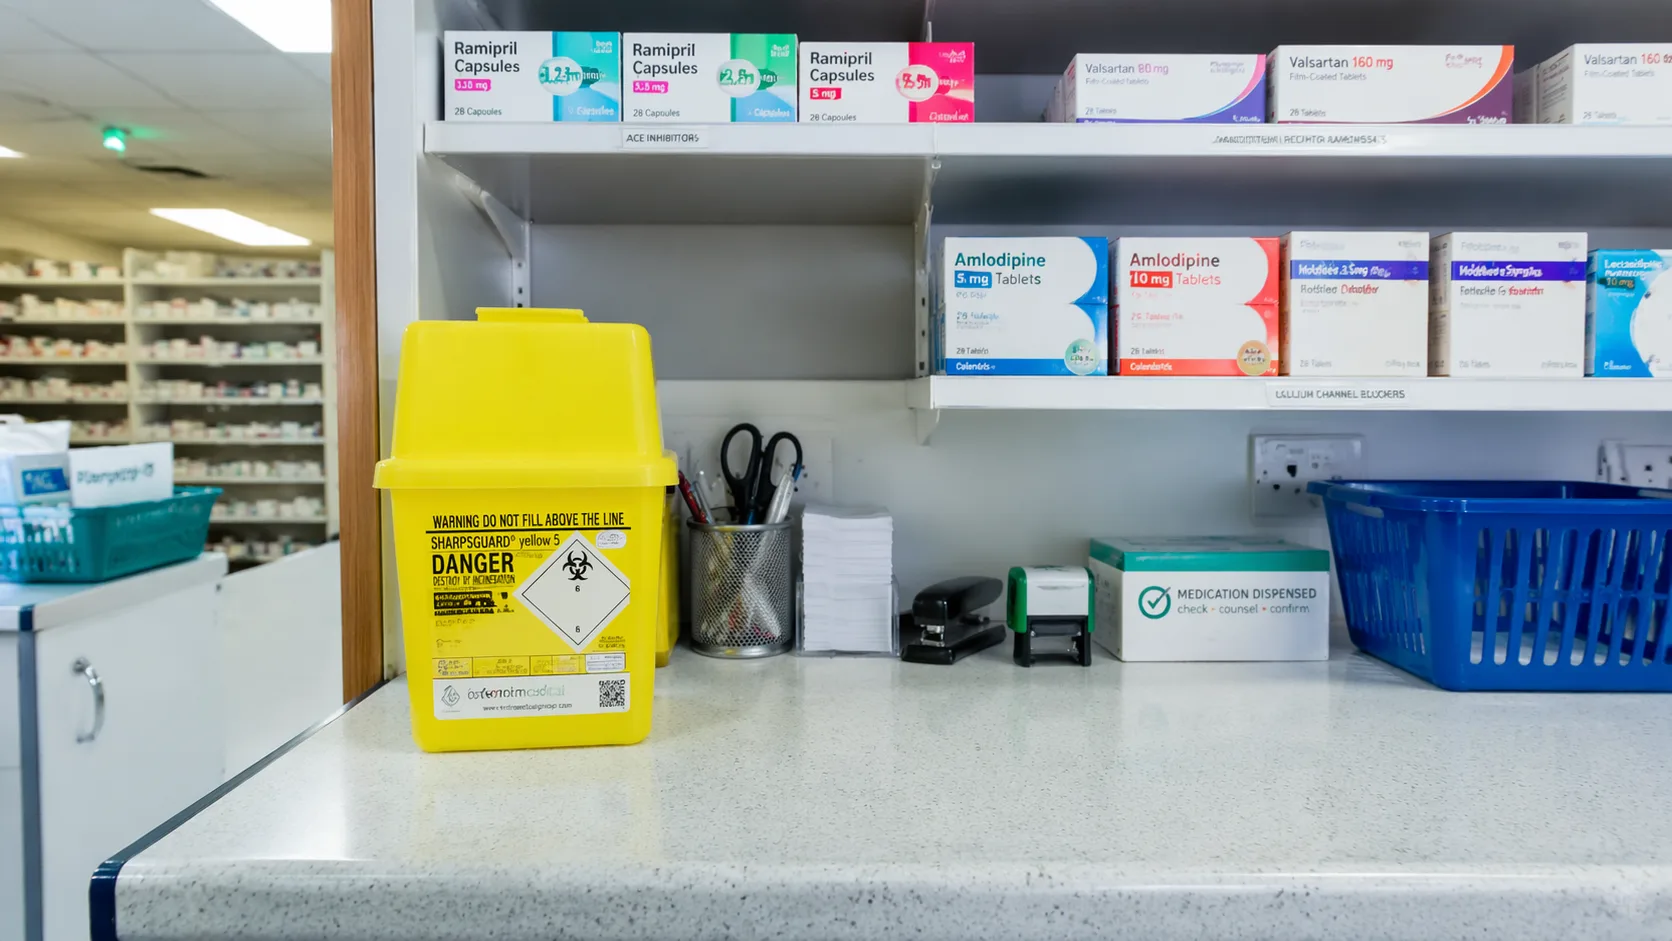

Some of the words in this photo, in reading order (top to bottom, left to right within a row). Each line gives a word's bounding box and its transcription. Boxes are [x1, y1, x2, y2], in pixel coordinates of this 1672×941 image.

[454, 41, 517, 57] Ramipril
[633, 43, 695, 59] Ramipril
[810, 52, 872, 67] Ramipril
[1289, 56, 1348, 68] Valsartan
[1352, 57, 1373, 68] 160
[1376, 58, 1393, 70] mg
[1584, 54, 1637, 65] Valsartan
[1641, 53, 1660, 64] 160
[454, 59, 520, 75] Capsules
[633, 61, 698, 77] Capsules
[1085, 63, 1135, 74] Valsartan
[1138, 63, 1151, 74] 80
[1153, 65, 1169, 75] mg
[810, 69, 875, 84] Capsules
[651, 83, 665, 93] mg
[821, 90, 836, 100] mg
[454, 107, 465, 116] 28
[633, 109, 643, 117] 28
[626, 134, 644, 142] ACE
[954, 252, 1046, 270] Amlodipine
[1130, 253, 1220, 270] Amlodipine
[969, 274, 989, 286] mg
[996, 272, 1041, 285] Tablets
[1133, 272, 1148, 284] 10
[1151, 275, 1170, 286] mg
[1176, 273, 1221, 285] Tablets
[433, 515, 479, 529] WARNING
[482, 514, 496, 527] DO
[500, 514, 519, 527] NOT
[522, 513, 543, 527] FILL
[545, 513, 579, 526] ABOVE
[581, 512, 599, 525] THE
[603, 512, 624, 525] LINE
[519, 534, 552, 550] yellow
[553, 534, 560, 546] 5
[432, 552, 514, 574] DANGER
[1177, 589, 1249, 600] MEDICATION
[1252, 588, 1316, 599] DISPENSED
[1177, 604, 1208, 614] check
[1219, 604, 1258, 614] counsel
